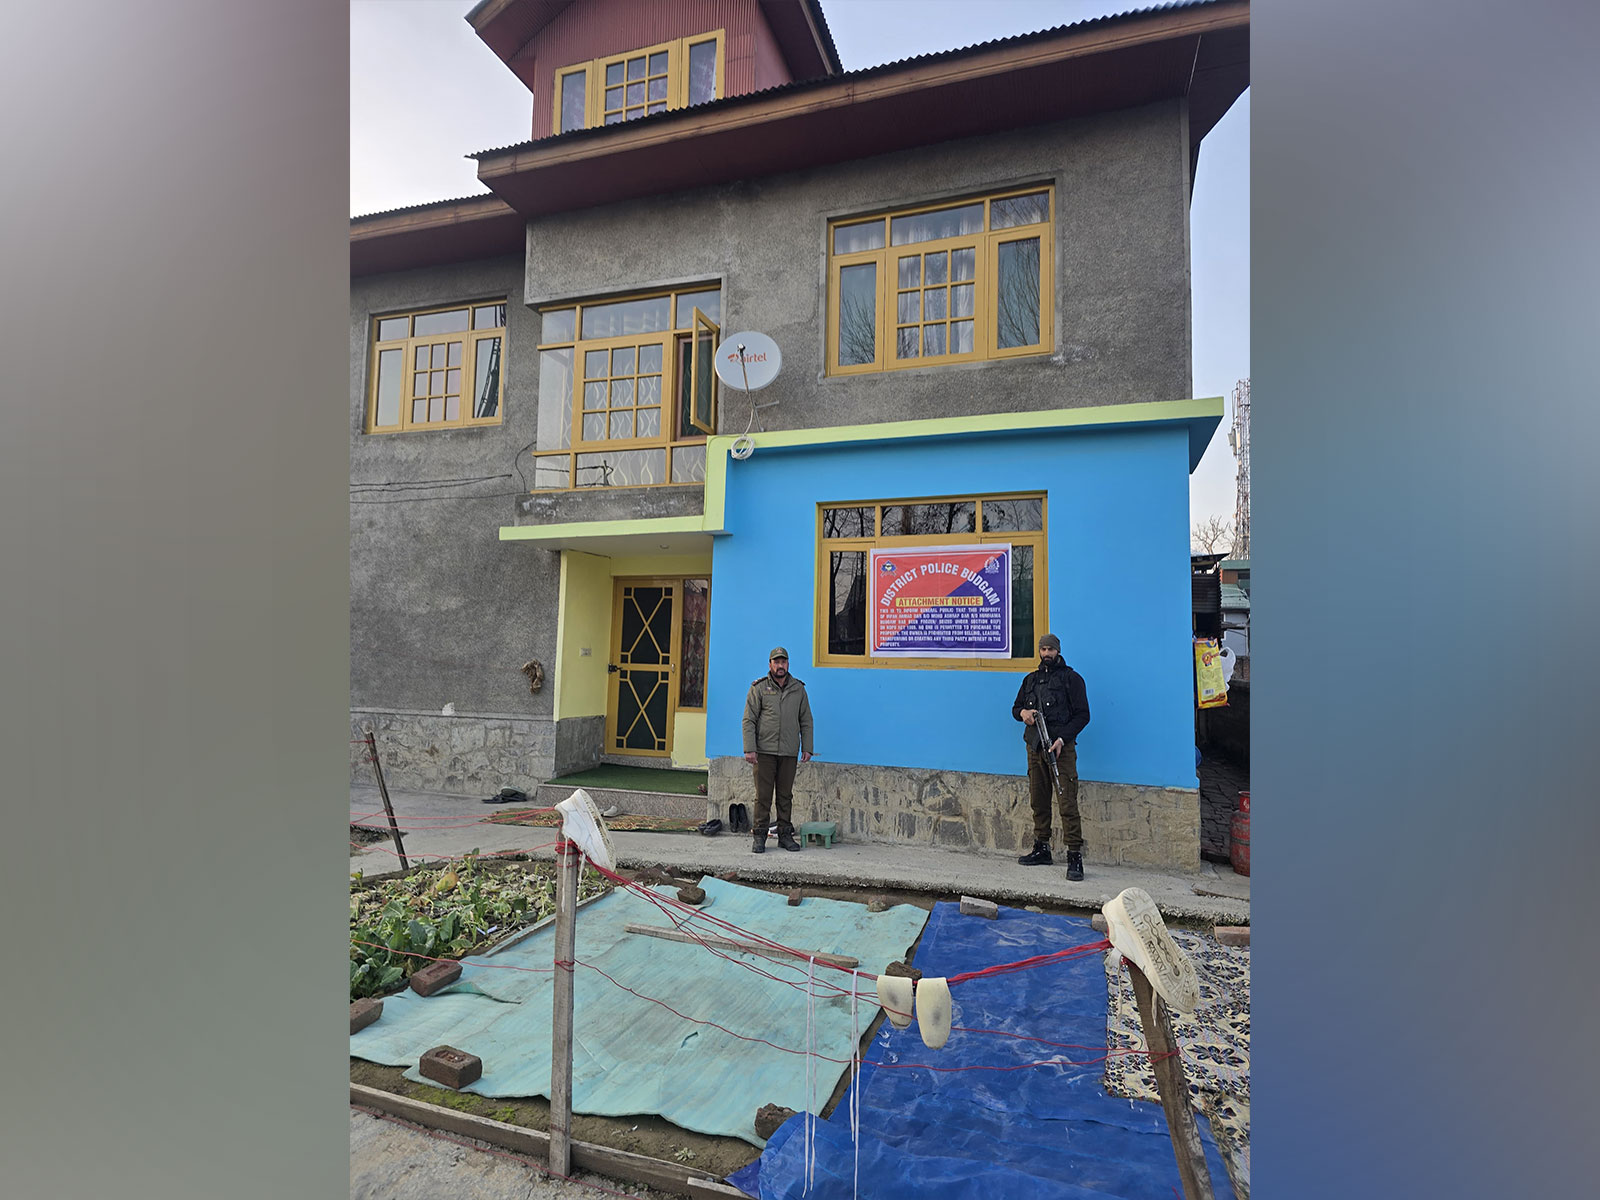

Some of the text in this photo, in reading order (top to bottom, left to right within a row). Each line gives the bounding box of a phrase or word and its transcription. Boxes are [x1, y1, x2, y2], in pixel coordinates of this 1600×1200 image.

[880, 568, 917, 606] DISTRICT
[920, 563, 959, 575] POLICE
[960, 567, 1000, 605] BUDGAM
[899, 597, 980, 606] ATTACHMENT NOTICE
